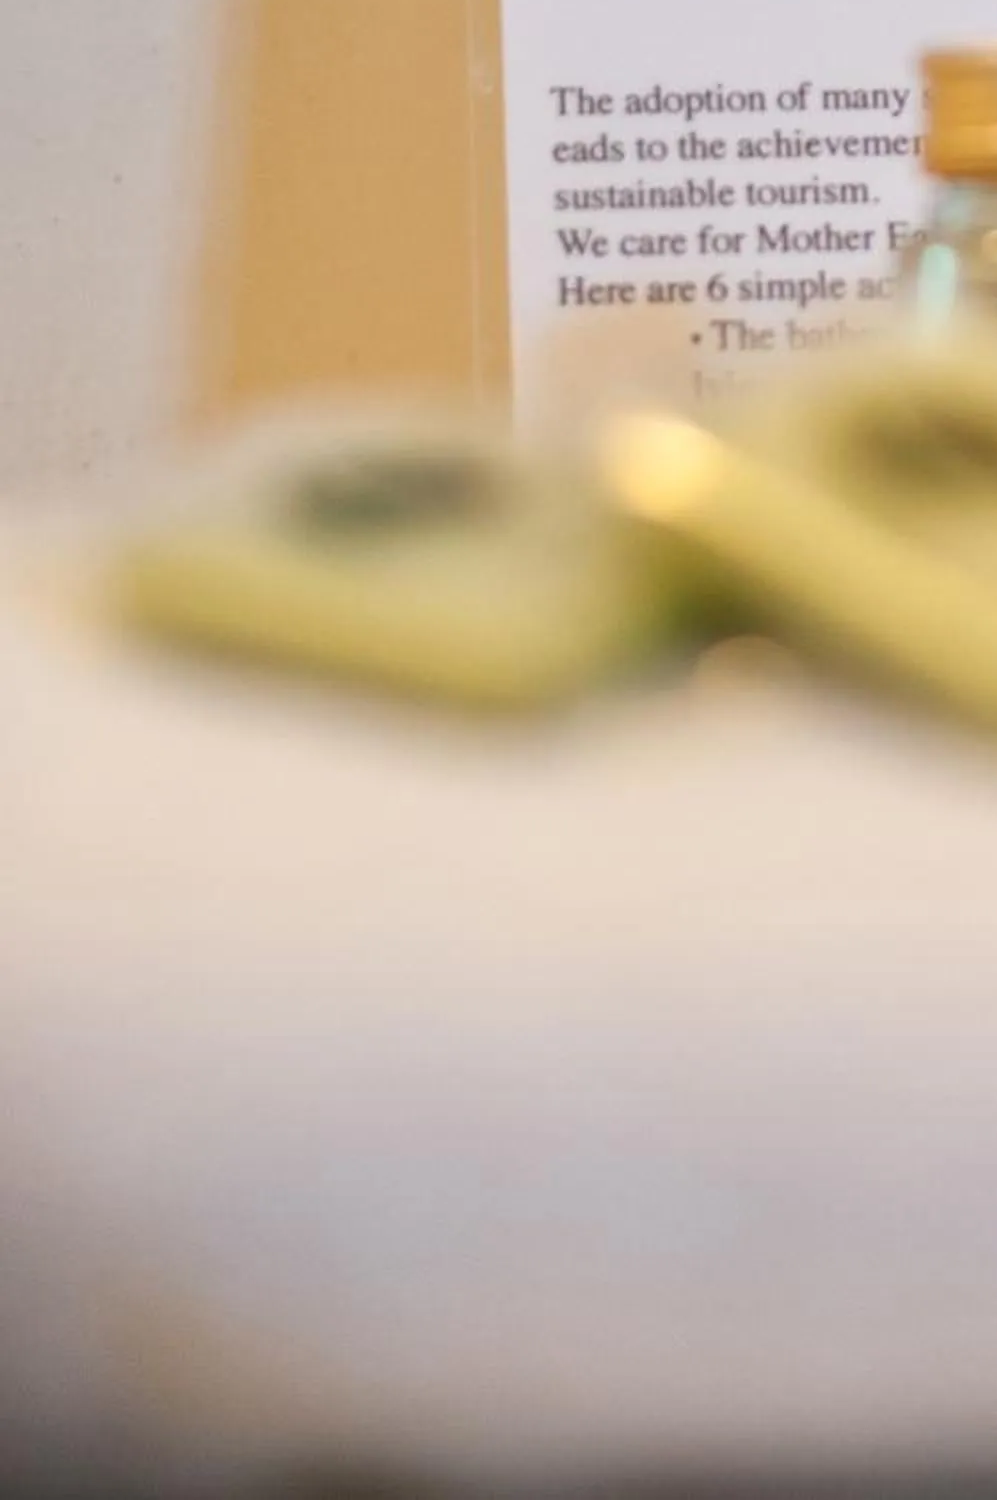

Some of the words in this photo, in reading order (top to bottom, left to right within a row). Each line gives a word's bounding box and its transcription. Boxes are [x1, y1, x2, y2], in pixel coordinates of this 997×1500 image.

[548, 85, 614, 118] The
[623, 82, 768, 125] adoption
[775, 80, 813, 114] of
[821, 86, 910, 120] many
[550, 132, 626, 165] eads
[634, 137, 670, 163] to
[676, 129, 727, 163] the
[553, 175, 736, 212] sustainable
[744, 174, 880, 208] tourism.
[555, 227, 609, 260] We
[618, 233, 688, 258] care
[696, 222, 747, 256] for
[756, 220, 876, 256] Mother
[558, 274, 637, 308] Here
[646, 281, 698, 305] are
[705, 273, 729, 302] 6
[737, 269, 846, 310] simple
